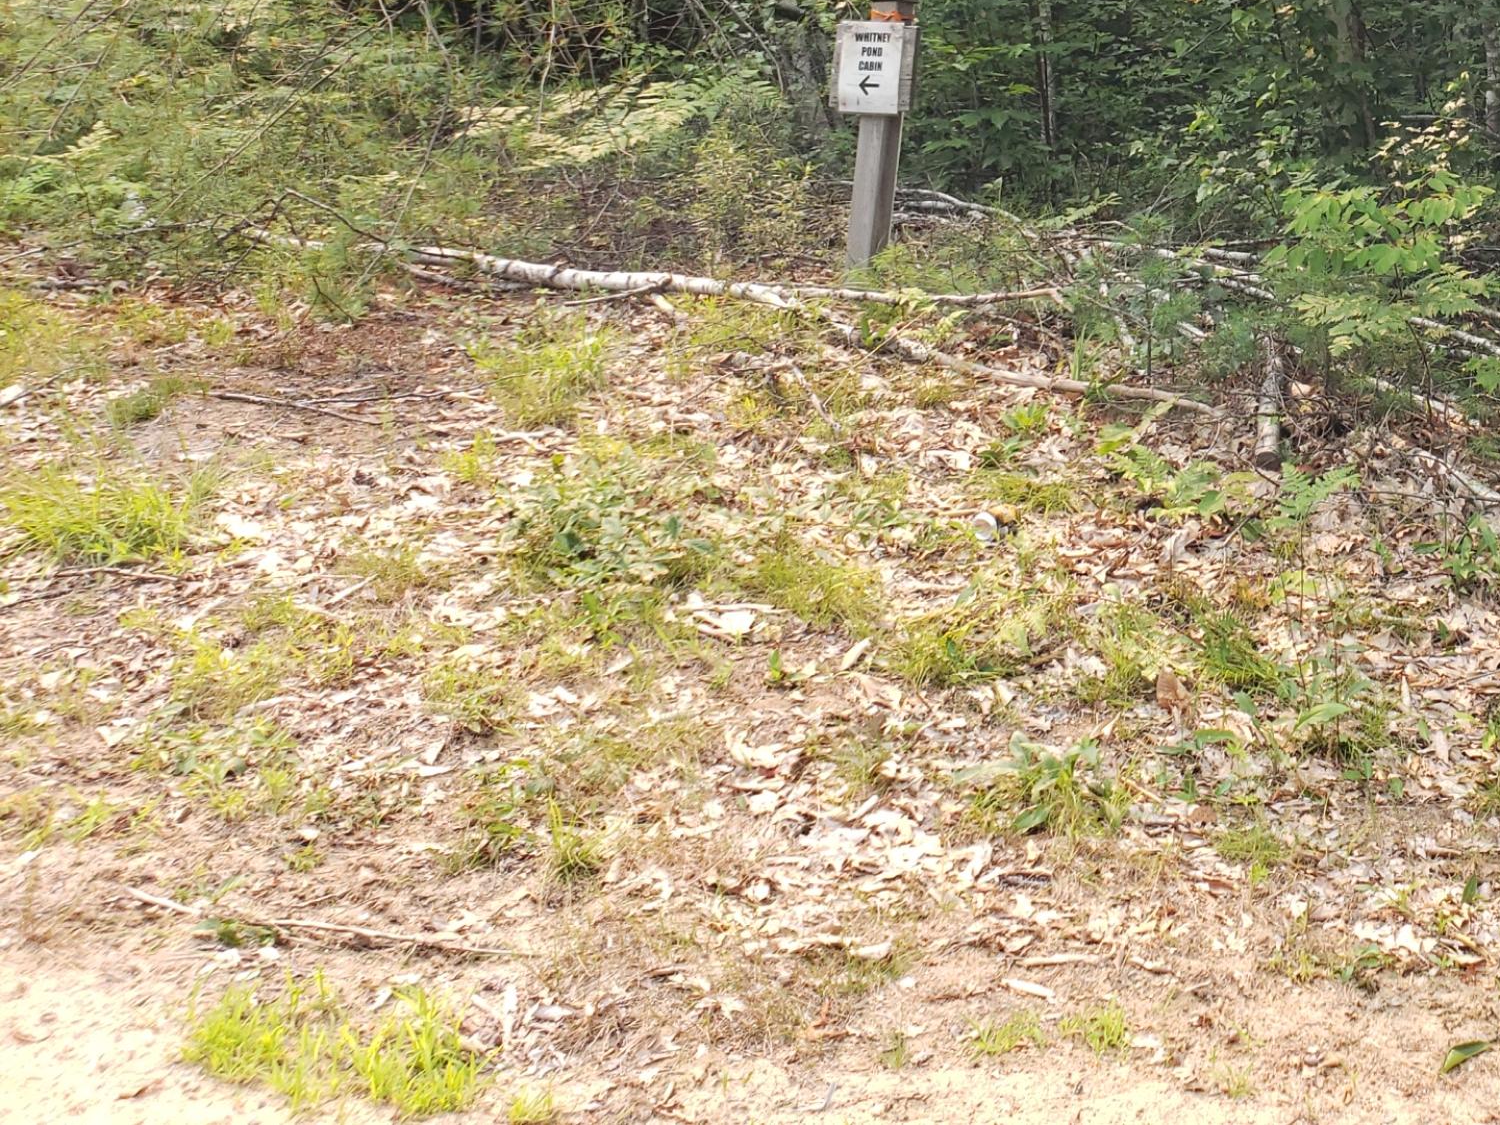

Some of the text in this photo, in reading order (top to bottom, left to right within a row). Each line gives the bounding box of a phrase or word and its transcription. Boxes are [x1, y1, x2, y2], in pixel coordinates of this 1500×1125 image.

[854, 32, 891, 43] WHITNEY
[861, 47, 883, 57] POND
[858, 61, 882, 71] CABIN
